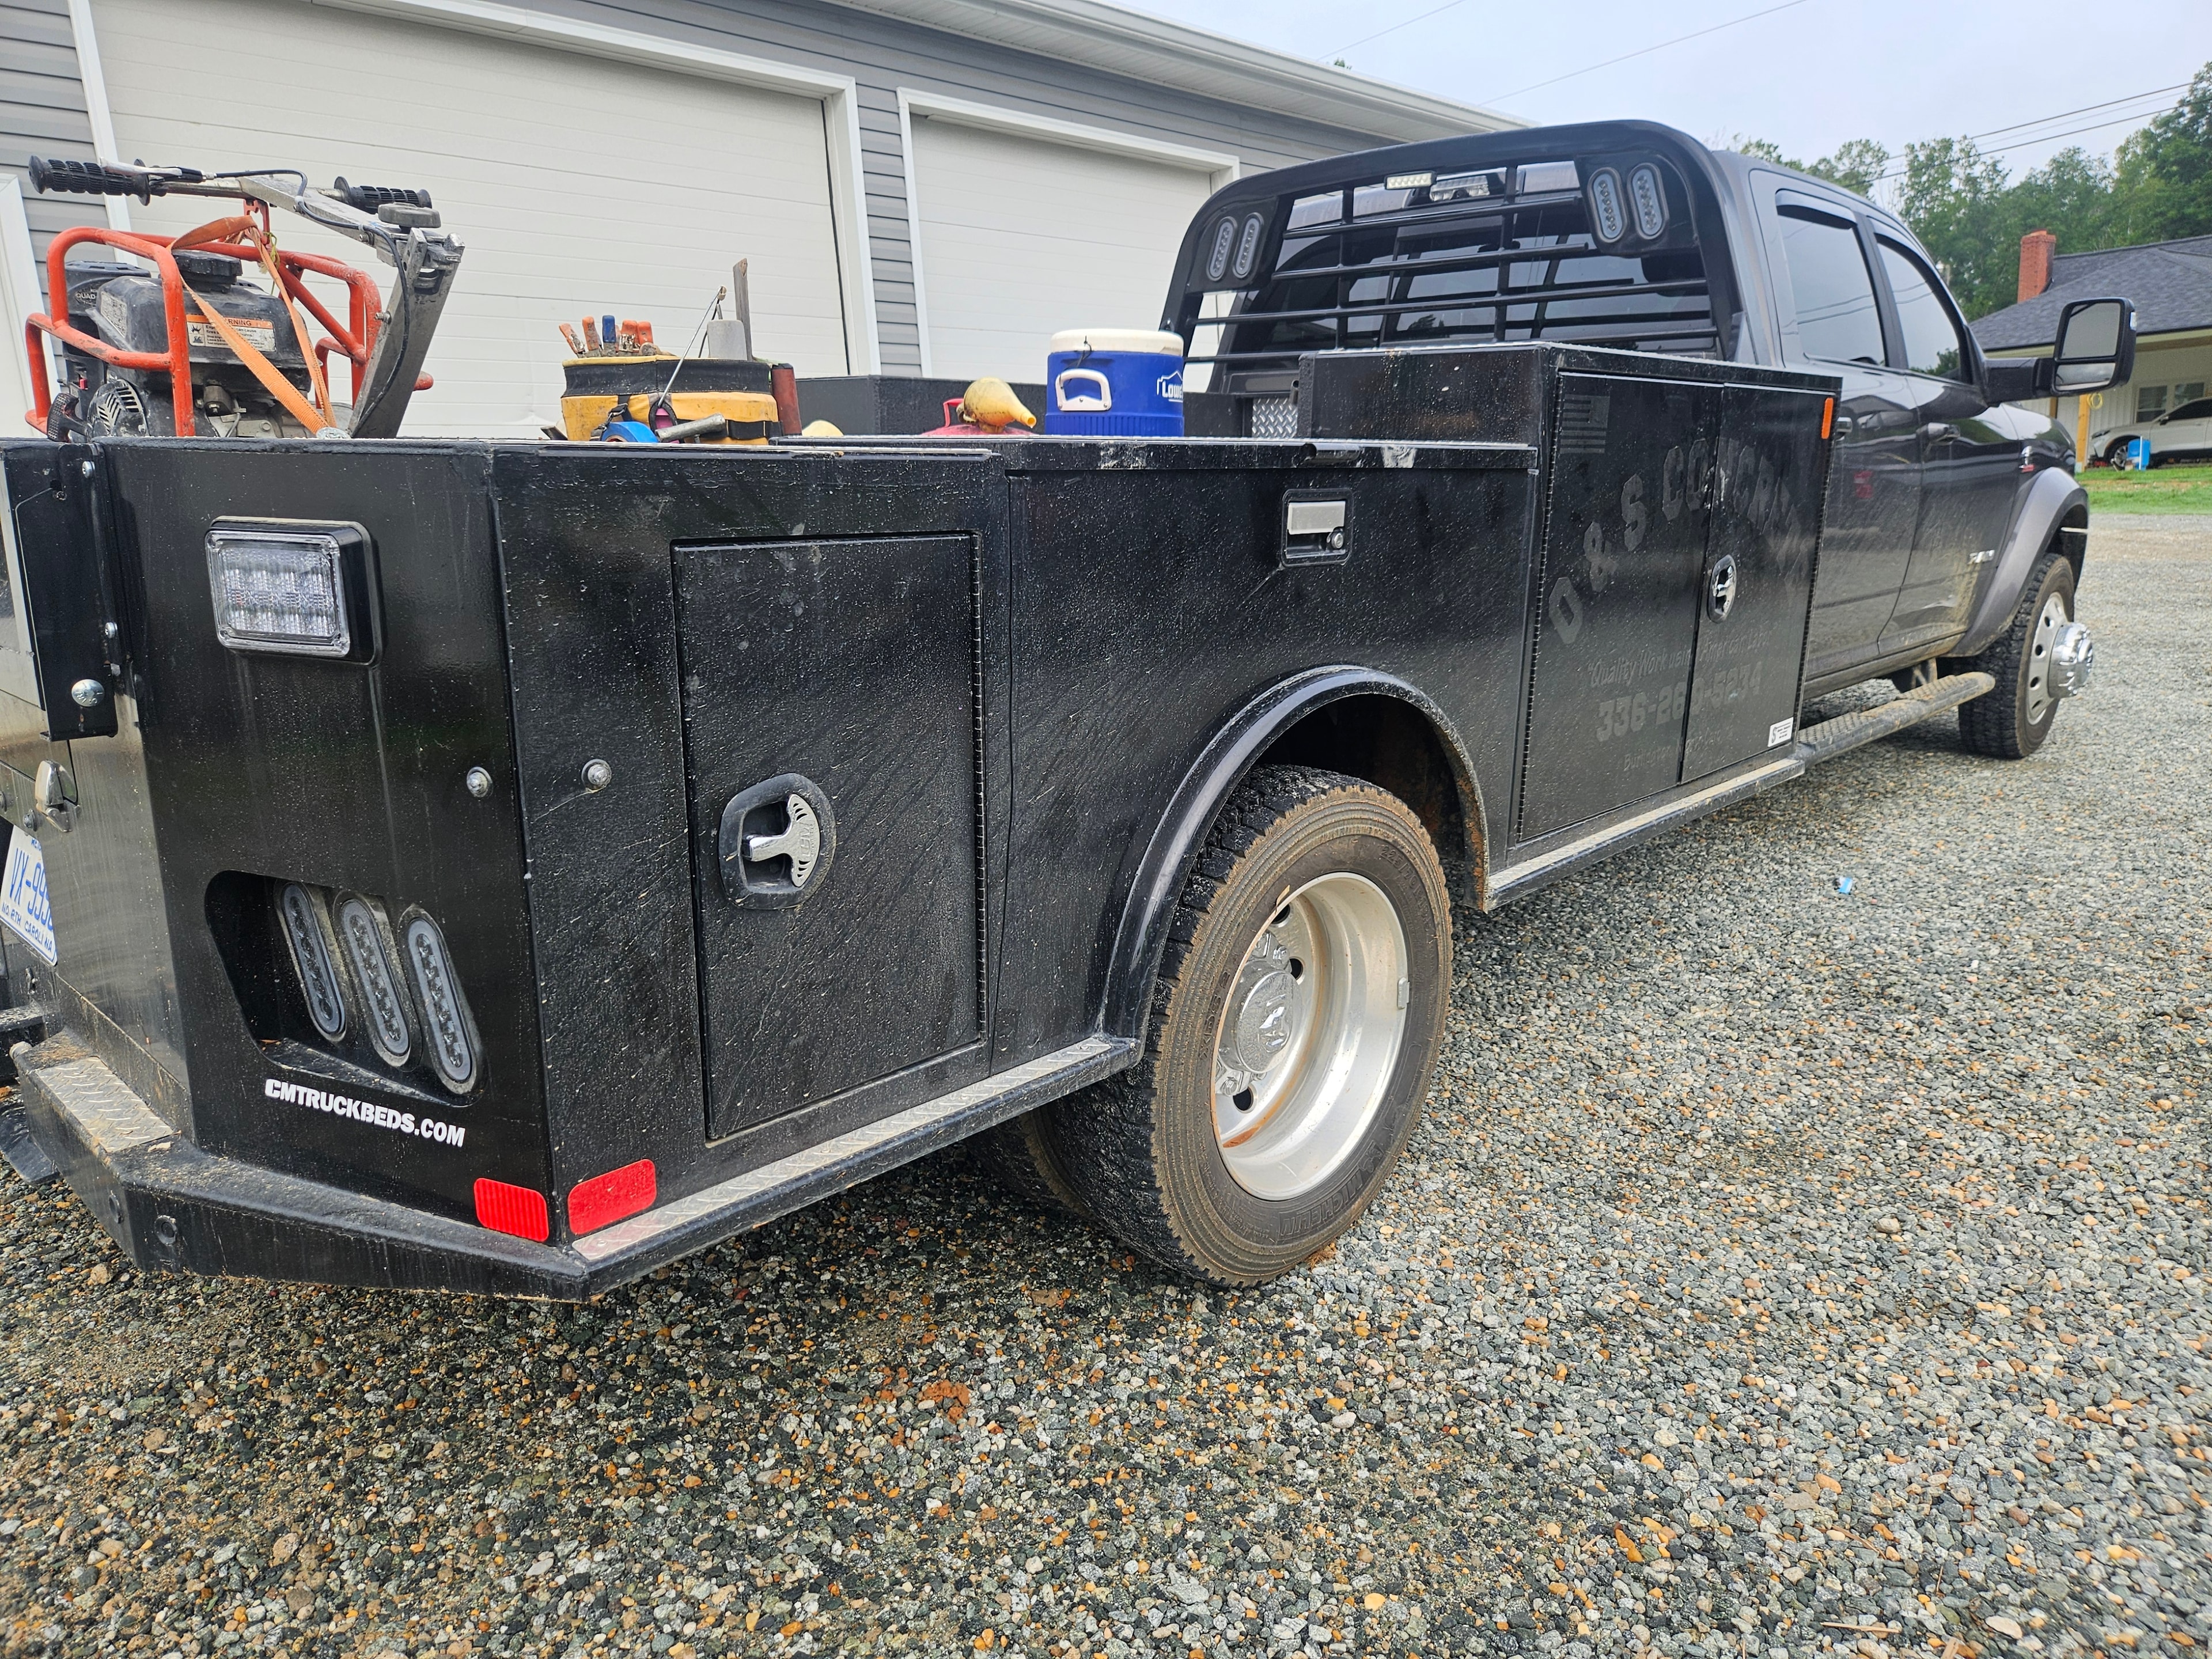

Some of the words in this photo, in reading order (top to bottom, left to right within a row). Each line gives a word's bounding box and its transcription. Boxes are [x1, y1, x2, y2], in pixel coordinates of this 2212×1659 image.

[1584, 521, 1619, 592] &
[1621, 474, 1646, 551] S
[2, 902, 21, 926] NORTH
[9, 848, 54, 931] VX-999
[1198, 995, 1222, 1058] XDS
[264, 1078, 466, 1148] CMTRUCKBEDS.COM
[1279, 1169, 1364, 1237] MICHELIN
